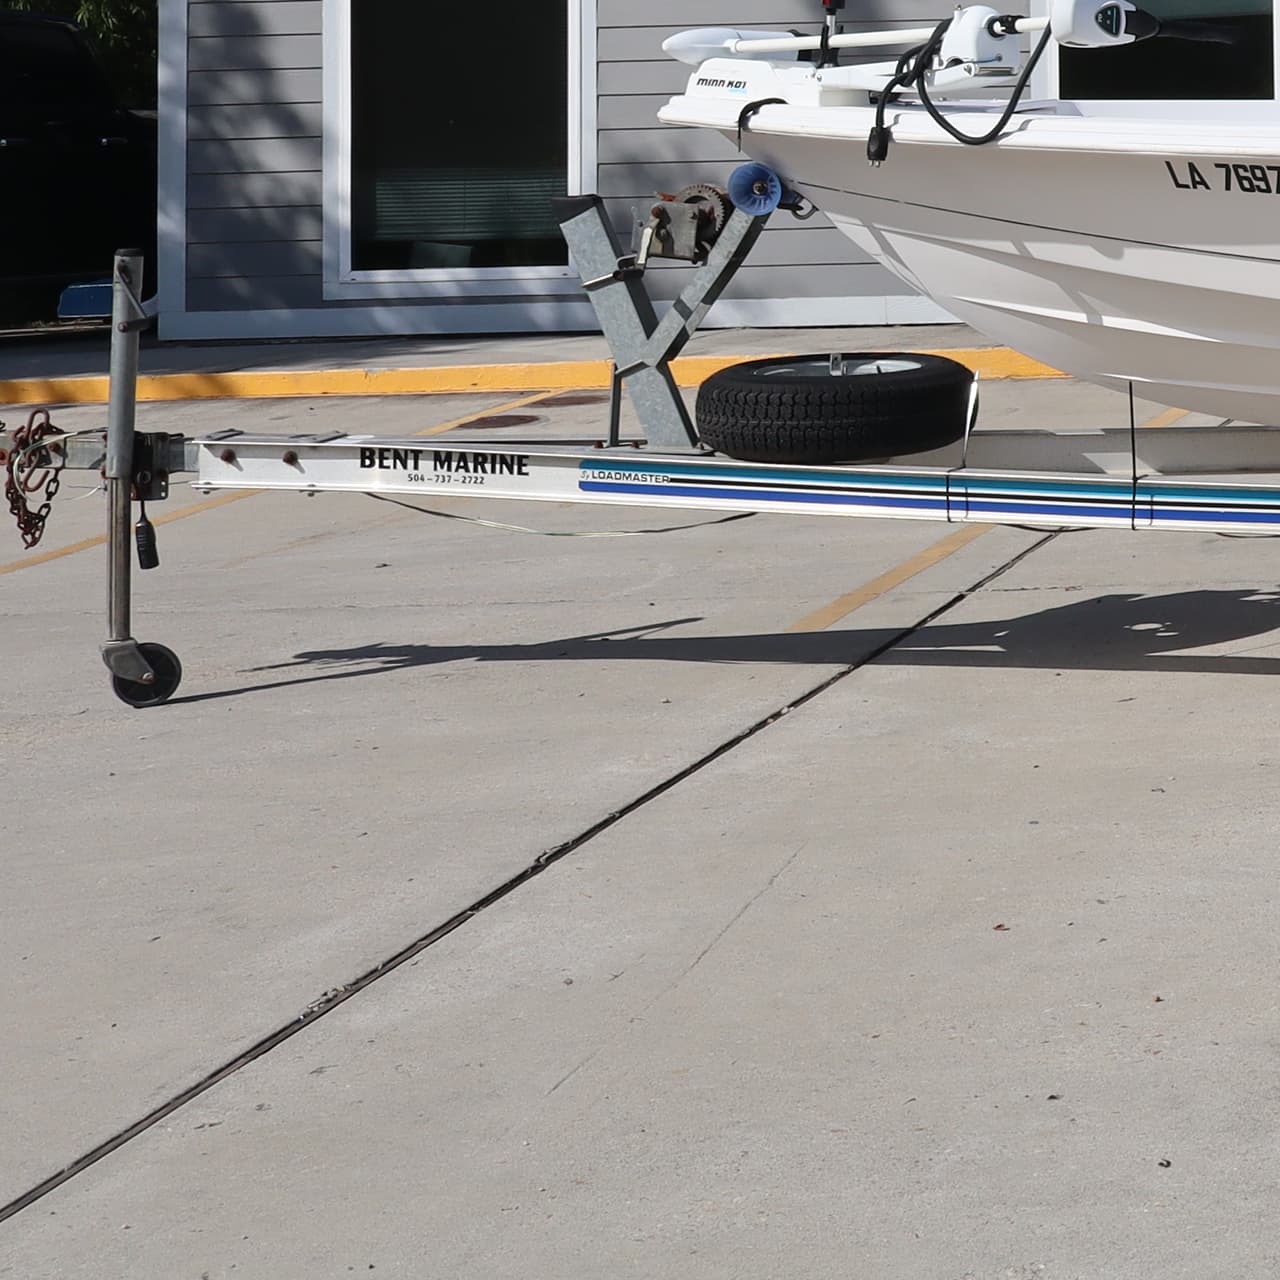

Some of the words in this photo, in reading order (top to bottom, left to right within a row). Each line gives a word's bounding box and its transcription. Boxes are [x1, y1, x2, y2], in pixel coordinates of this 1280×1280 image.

[1165, 161, 1211, 190] LA
[360, 447, 423, 471] BENT
[433, 449, 530, 476] MARINE
[591, 471, 670, 483] LOADMASTER
